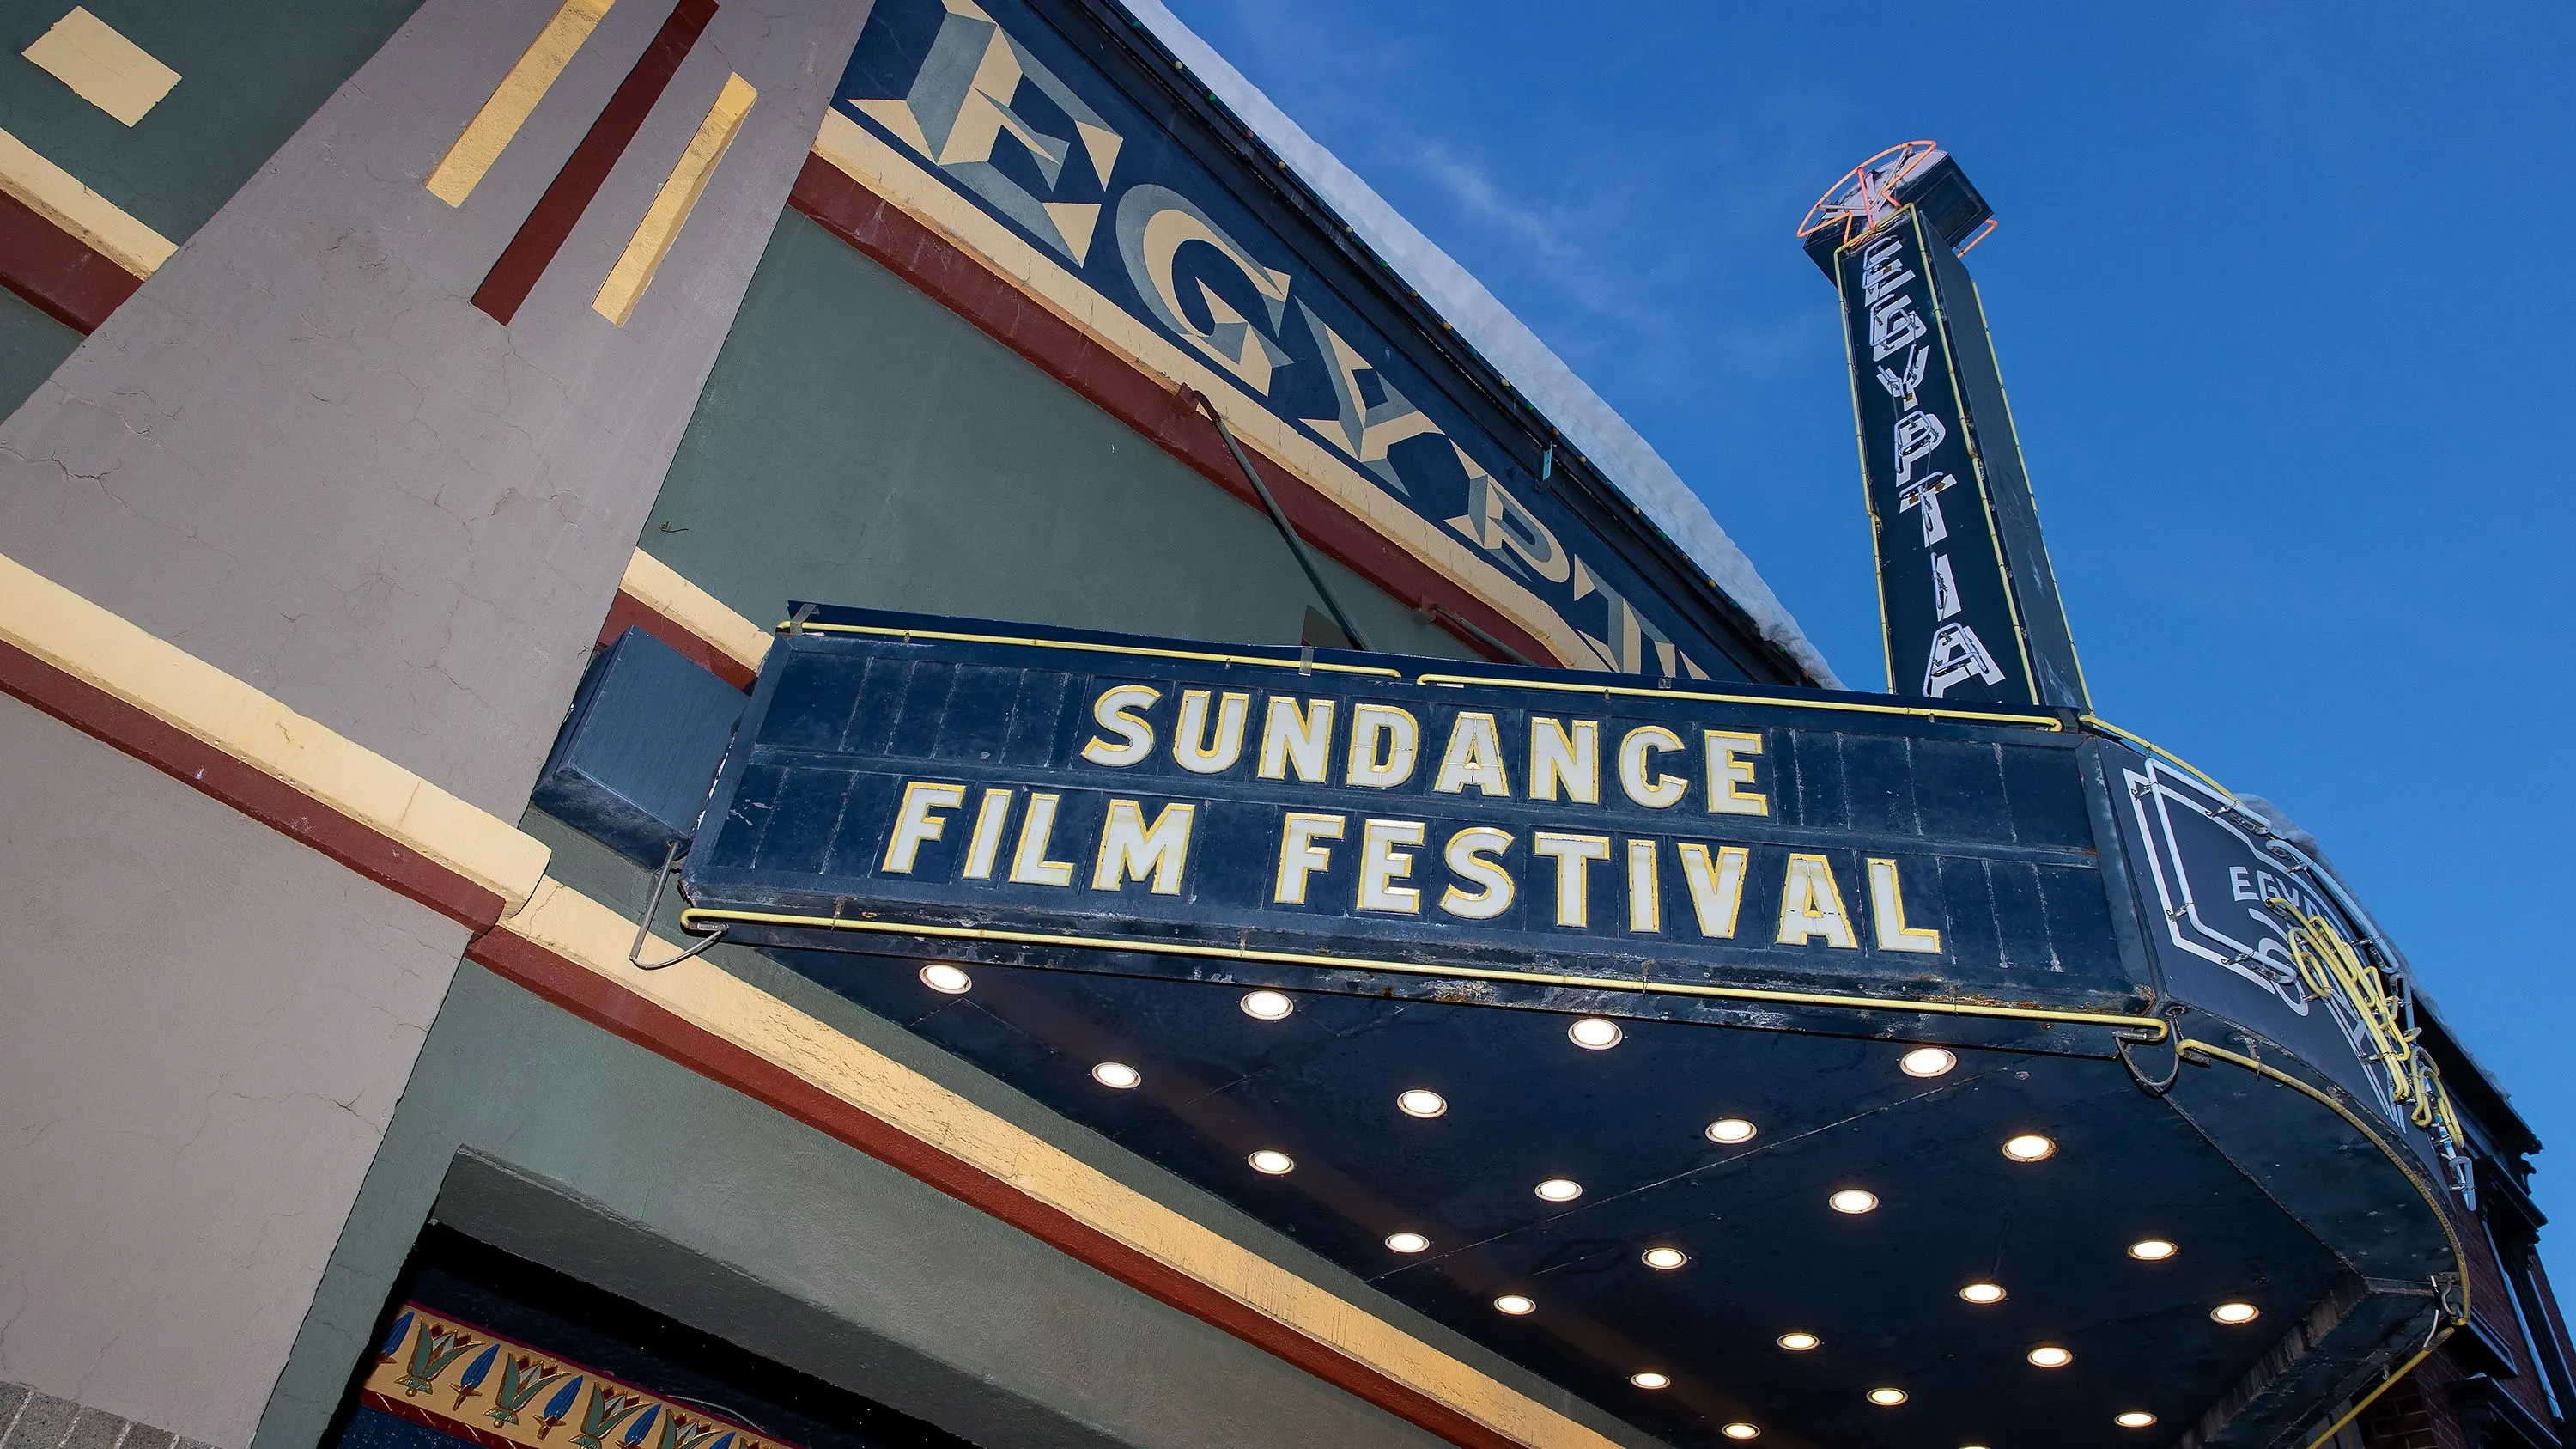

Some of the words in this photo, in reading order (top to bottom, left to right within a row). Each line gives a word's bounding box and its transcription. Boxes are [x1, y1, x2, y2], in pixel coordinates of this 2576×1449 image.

[846, 0, 1710, 680] EGYPT
[1080, 685, 1770, 818] SUNDANCE
[881, 780, 1195, 896] FILM
[1273, 812, 1942, 955] FESTIVAL
